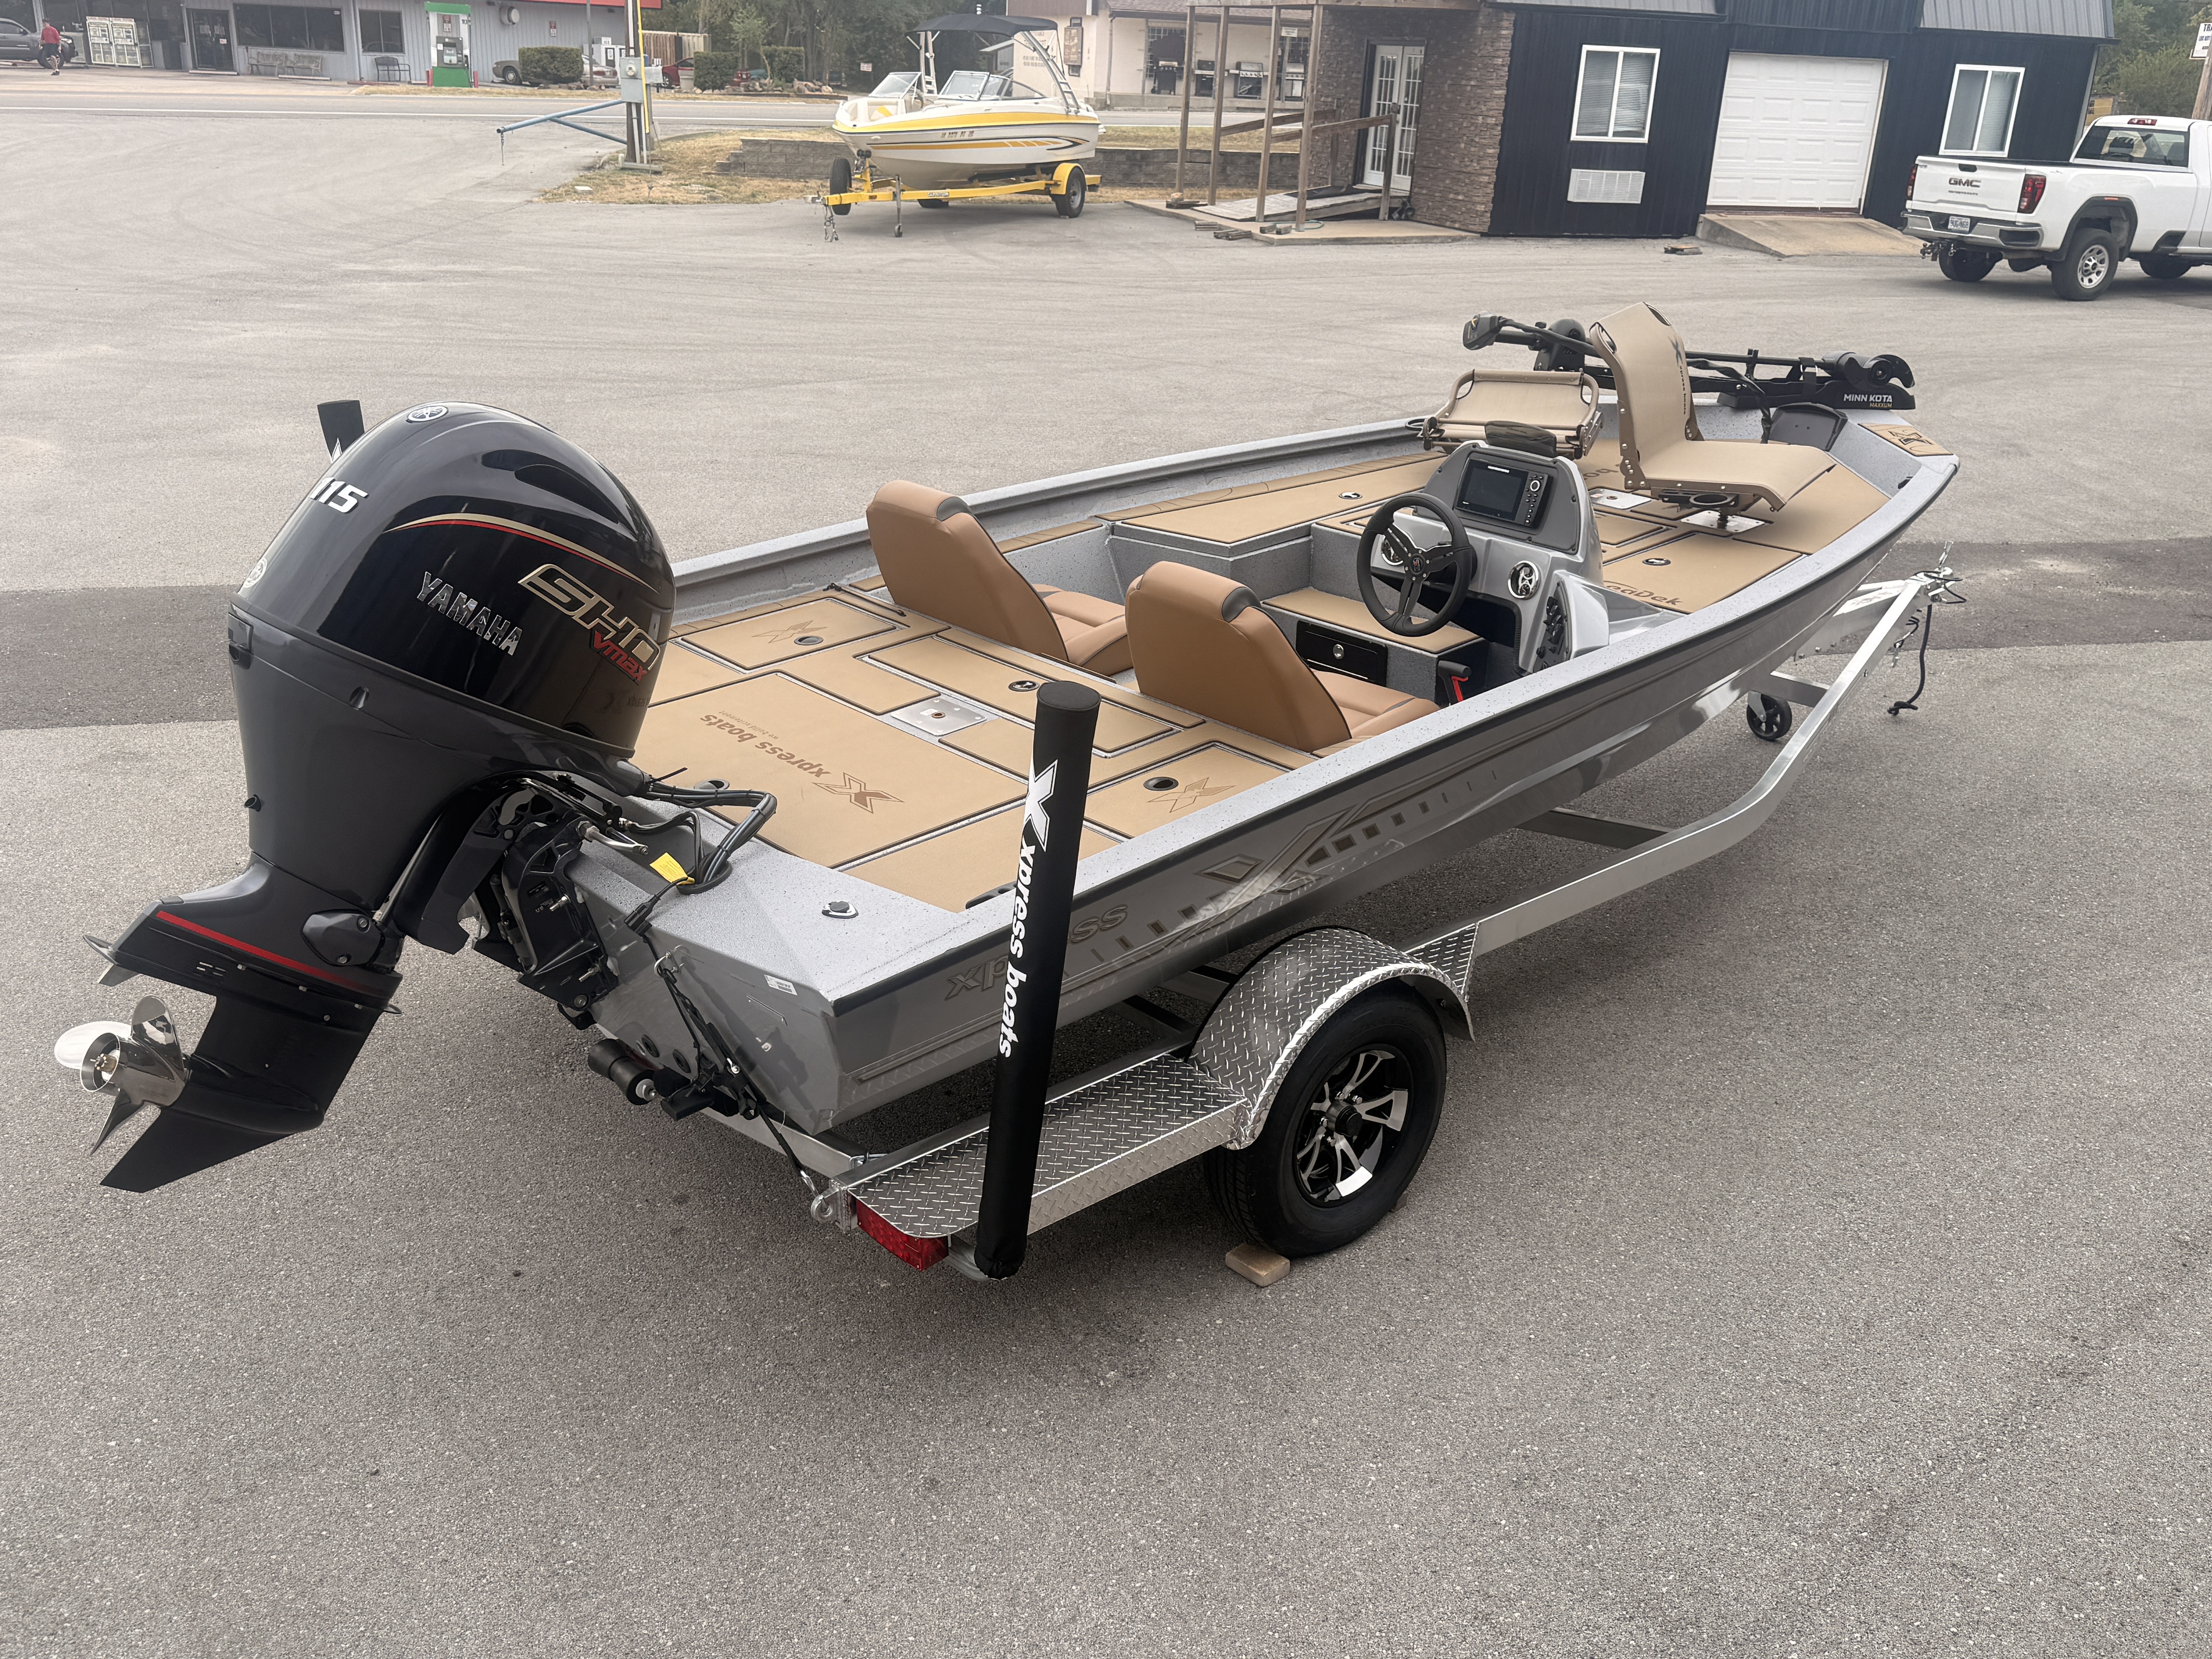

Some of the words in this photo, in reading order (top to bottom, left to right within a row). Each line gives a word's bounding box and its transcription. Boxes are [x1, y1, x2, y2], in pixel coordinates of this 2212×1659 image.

[1949, 177, 1982, 188] GMC
[1843, 394, 1868, 402] MINN
[309, 477, 369, 513] 115
[417, 571, 523, 656] YAMAHA
[518, 563, 661, 671] SHO
[700, 714, 757, 743] boats
[755, 741, 832, 778] xpress
[1010, 837, 1036, 958] xpress
[1000, 961, 1027, 1058] boats
